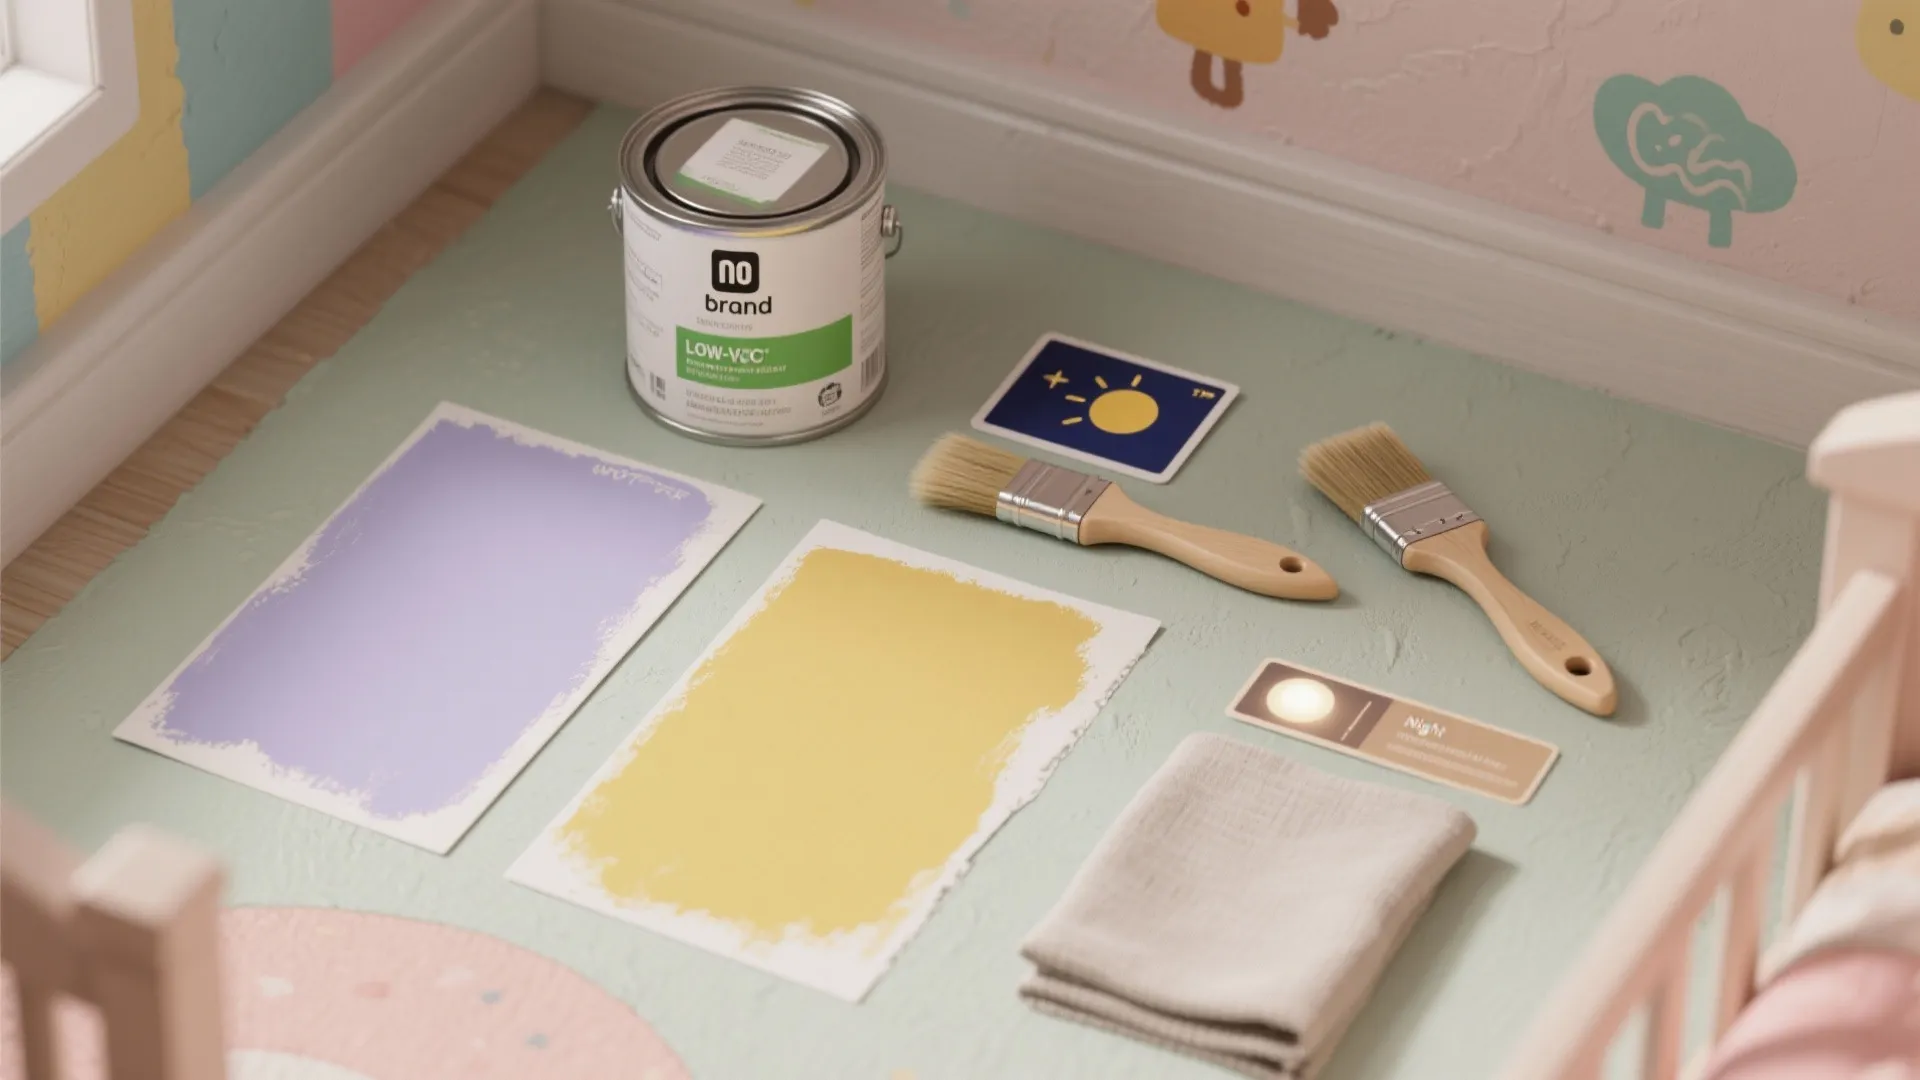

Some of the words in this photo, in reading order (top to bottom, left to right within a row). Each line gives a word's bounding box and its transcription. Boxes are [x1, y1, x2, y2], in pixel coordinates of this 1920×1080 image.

[719, 259, 753, 286] no
[705, 294, 773, 315] brand
[1404, 715, 1446, 737] Night
